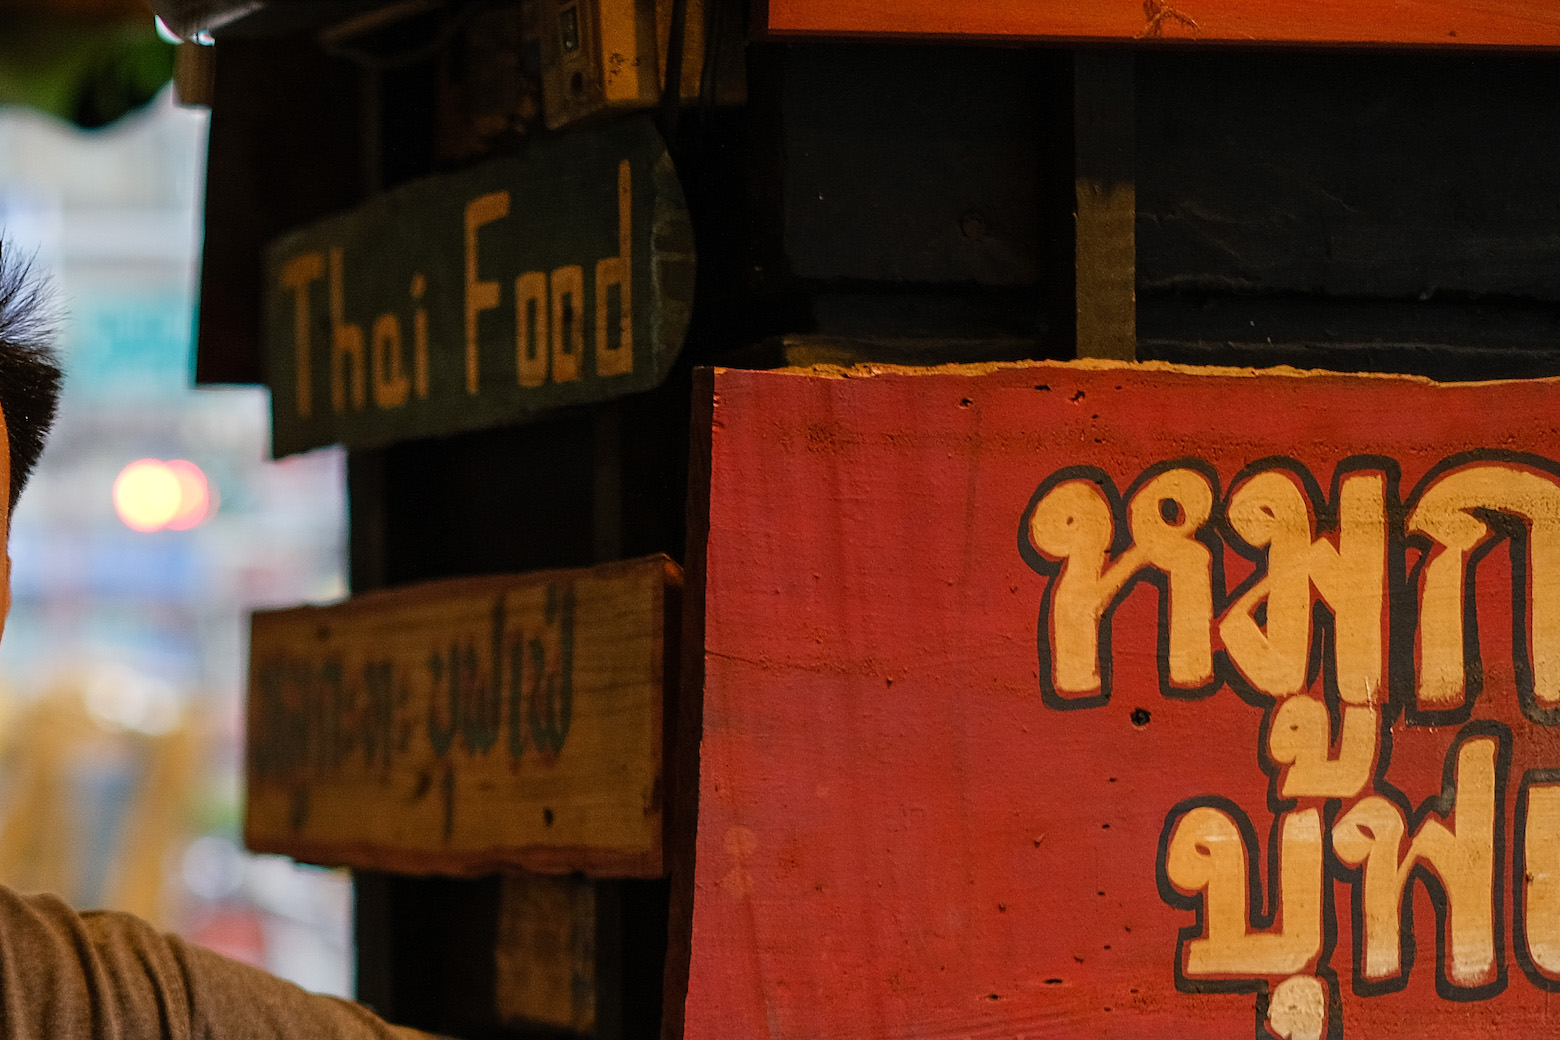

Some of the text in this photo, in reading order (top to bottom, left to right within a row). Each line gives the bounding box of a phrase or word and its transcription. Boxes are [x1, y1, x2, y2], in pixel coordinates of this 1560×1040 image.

[280, 159, 635, 417] Thai Food
[1018, 448, 1560, 800] หมูก
